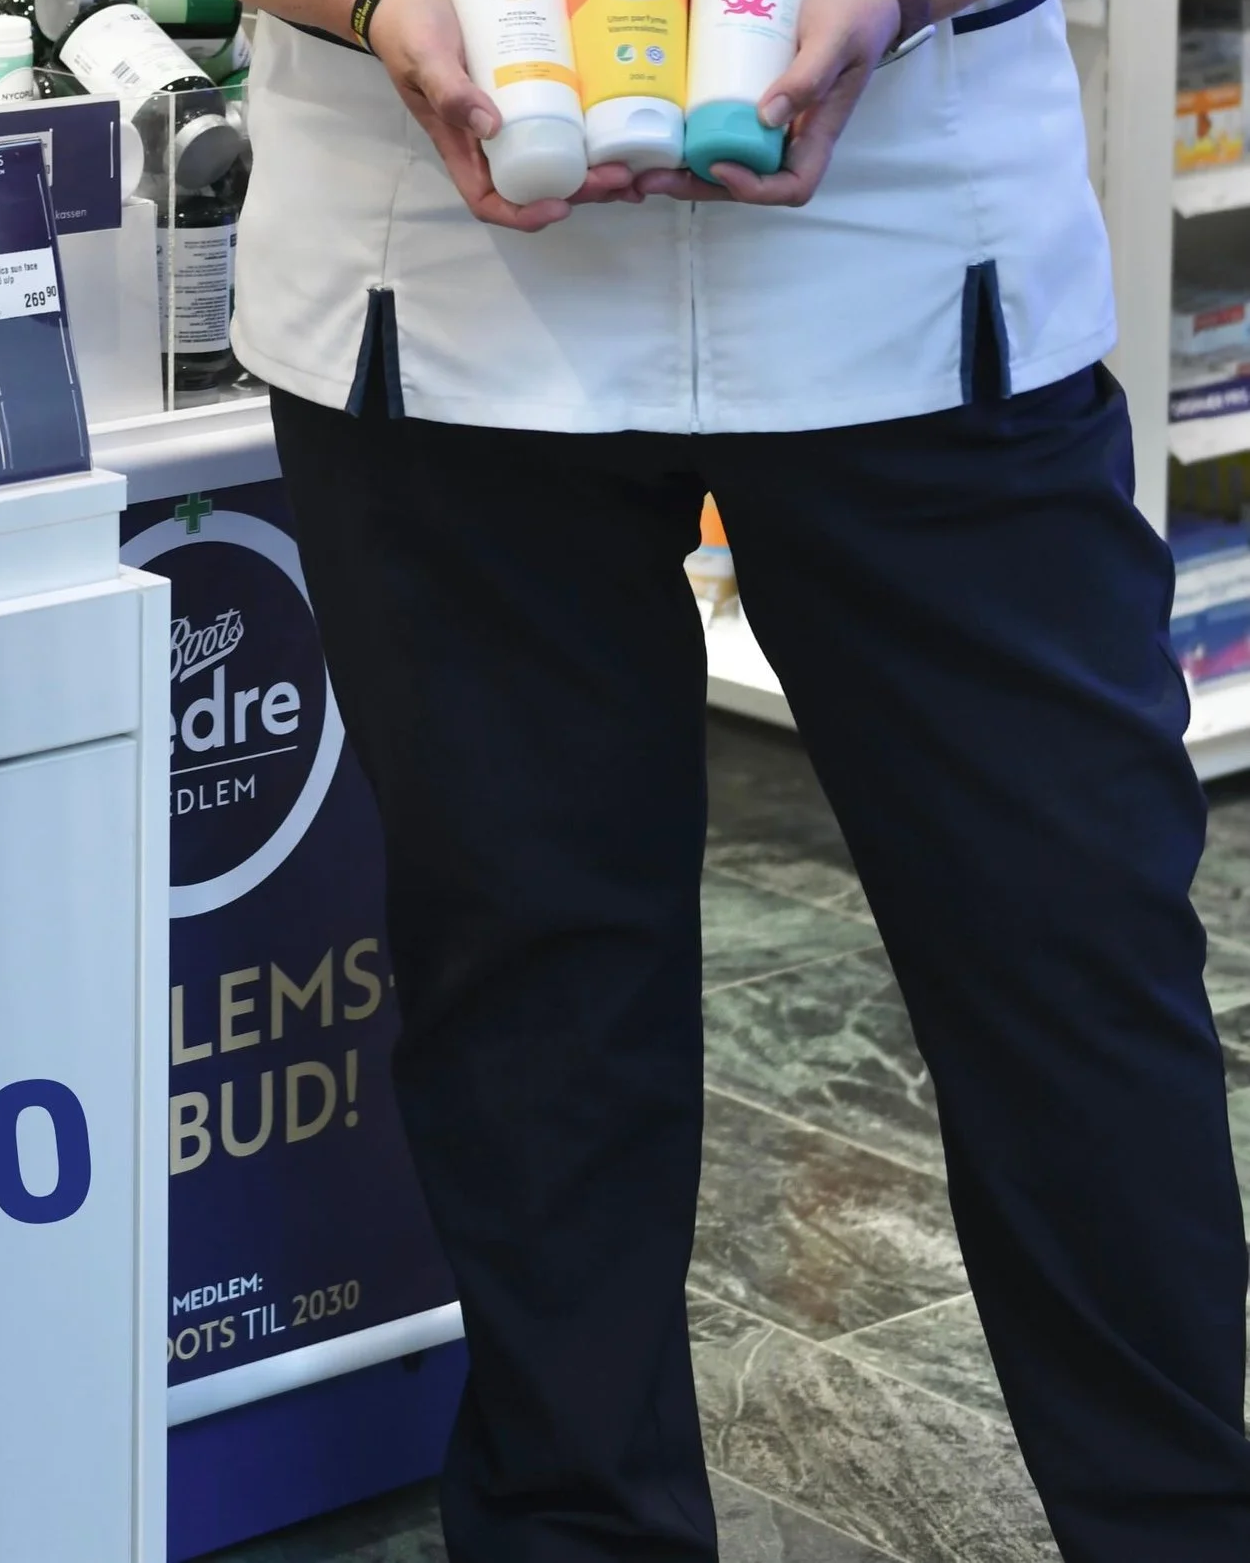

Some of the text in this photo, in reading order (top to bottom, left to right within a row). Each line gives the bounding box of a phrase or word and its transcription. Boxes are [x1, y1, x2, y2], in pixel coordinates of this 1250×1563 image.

[55, 208, 87, 220] kassen
[24, 285, 57, 308] 269 90
[169, 1049, 359, 1175] BUD!
[173, 1272, 264, 1316] MEDLEM:
[242, 1303, 285, 1340] TIL
[292, 1279, 360, 1326] 2030
